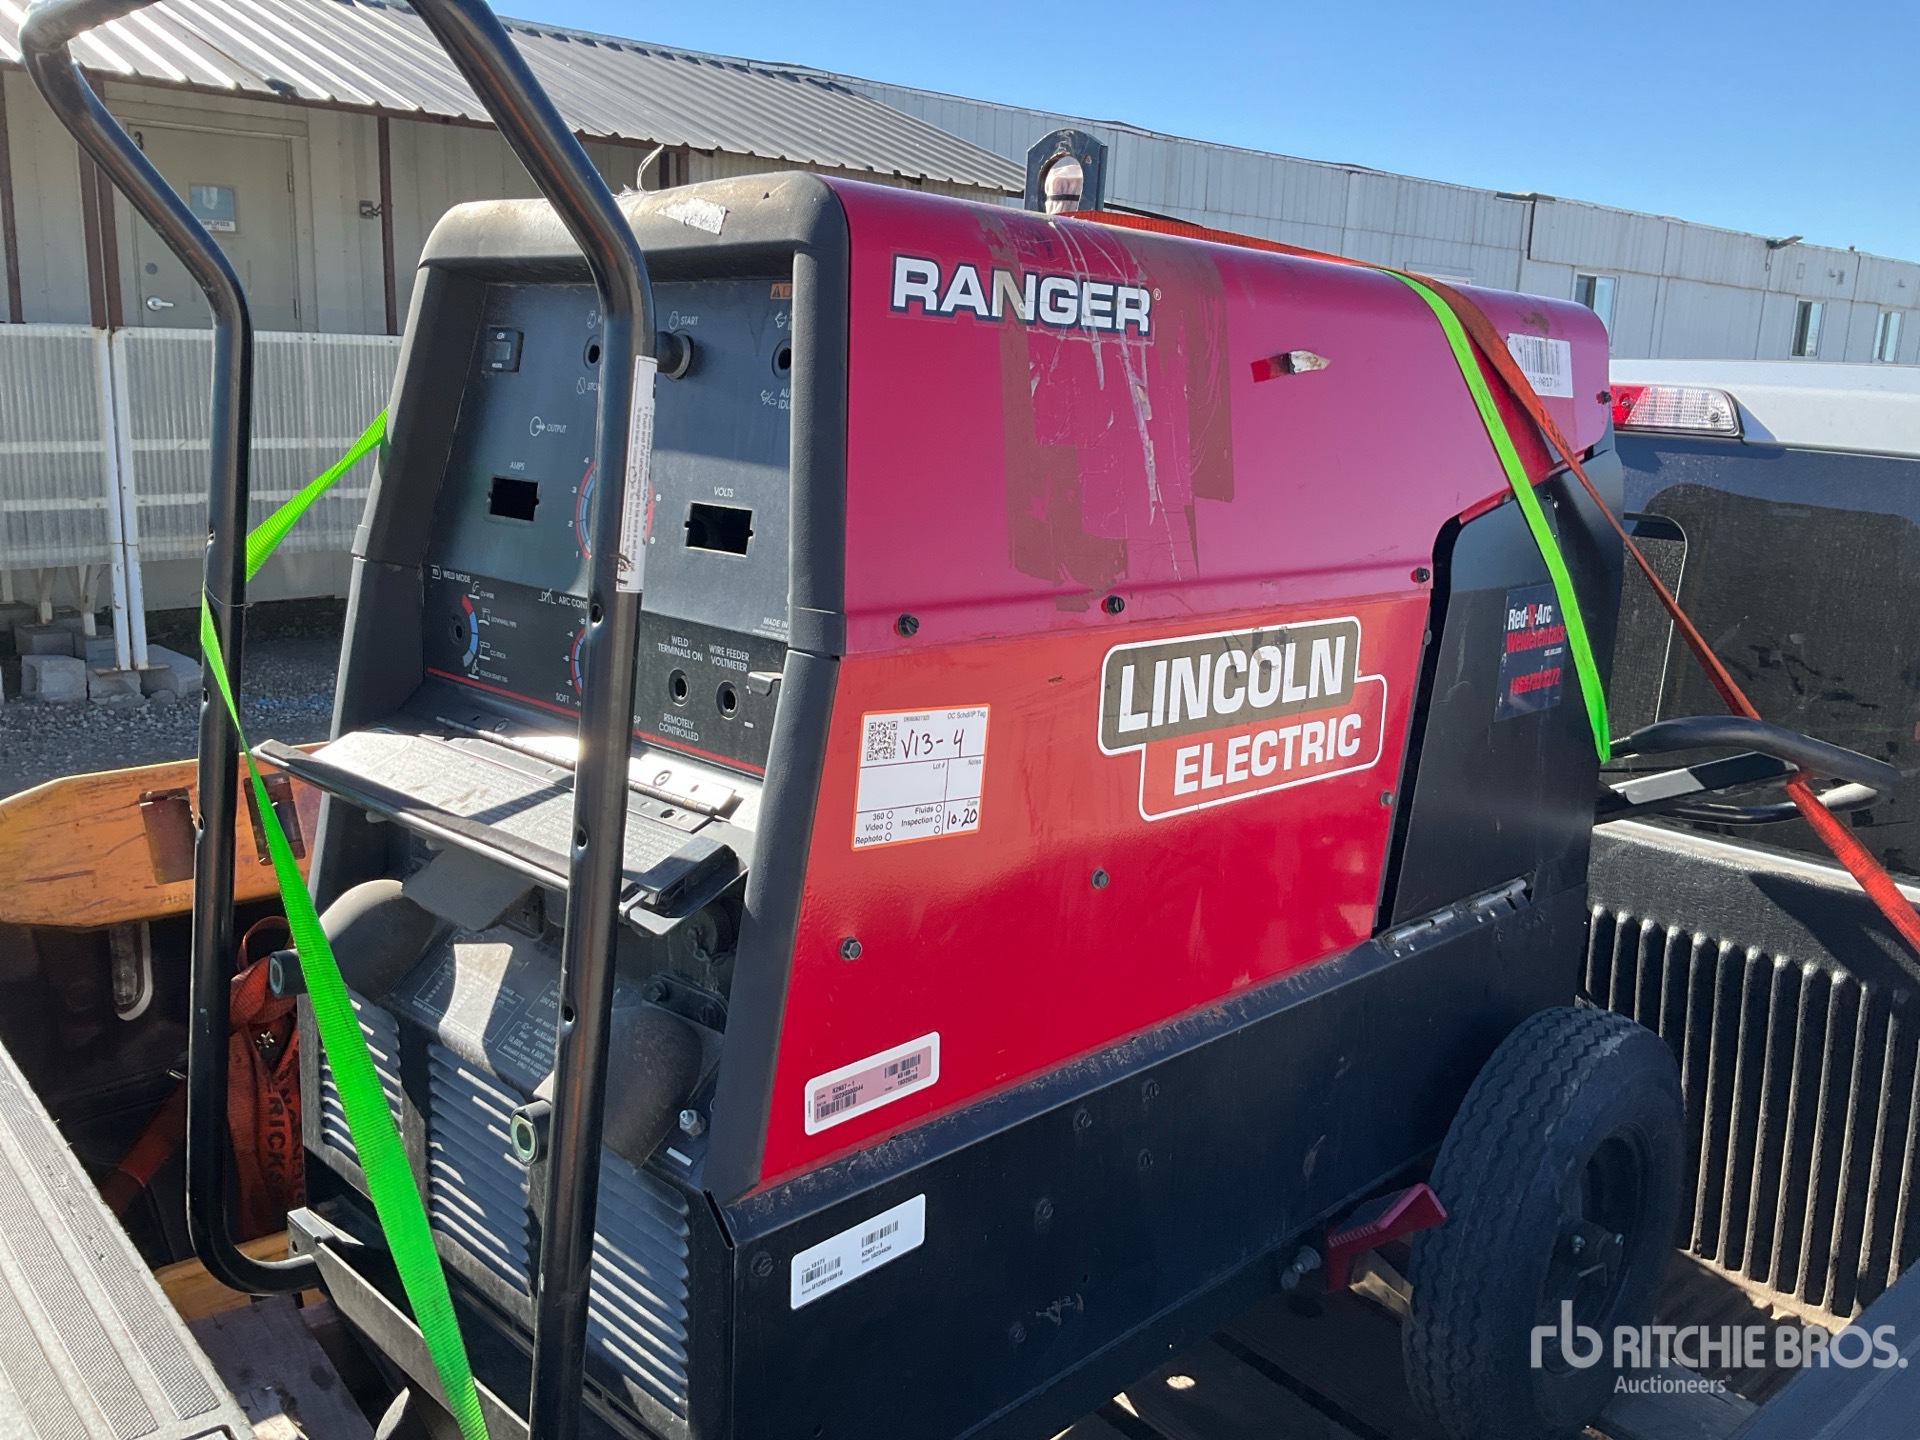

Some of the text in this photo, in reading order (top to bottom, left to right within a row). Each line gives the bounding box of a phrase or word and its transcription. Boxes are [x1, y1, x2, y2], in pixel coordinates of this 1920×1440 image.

[892, 254, 1151, 334] RANGER
[680, 315, 699, 326] START
[587, 382, 599, 391] STO
[777, 399, 791, 410] IDL
[546, 423, 567, 434] OUTPUT
[583, 456, 590, 464] 4
[509, 461, 526, 471] AMPS
[571, 486, 577, 495] 3
[713, 487, 734, 498] VOLTS
[655, 494, 662, 502] 8
[634, 509, 640, 518] be
[649, 536, 656, 545] 9
[575, 550, 579, 558] 1
[443, 570, 471, 584] WELD MODE
[558, 595, 589, 610] ARC CONT
[763, 616, 781, 628] MADE
[781, 620, 789, 629] IN
[671, 635, 689, 648] WELD
[657, 642, 703, 662] TERMINALS ON
[708, 643, 750, 663] WIRE FEEDER
[710, 654, 748, 673] VOLTMETER
[1117, 635, 1346, 733] LINCOLN
[555, 691, 570, 704] SOFT
[663, 712, 695, 730] REMOTELY
[658, 722, 699, 742] CONTROLLED
[1173, 713, 1362, 796] ELECTRIC
[932, 762, 942, 770] Lot
[914, 805, 934, 815] Fluids
[872, 812, 885, 821] 360
[865, 823, 884, 832] Video
[901, 816, 934, 829] Inspection
[855, 835, 883, 846] Rephoto
